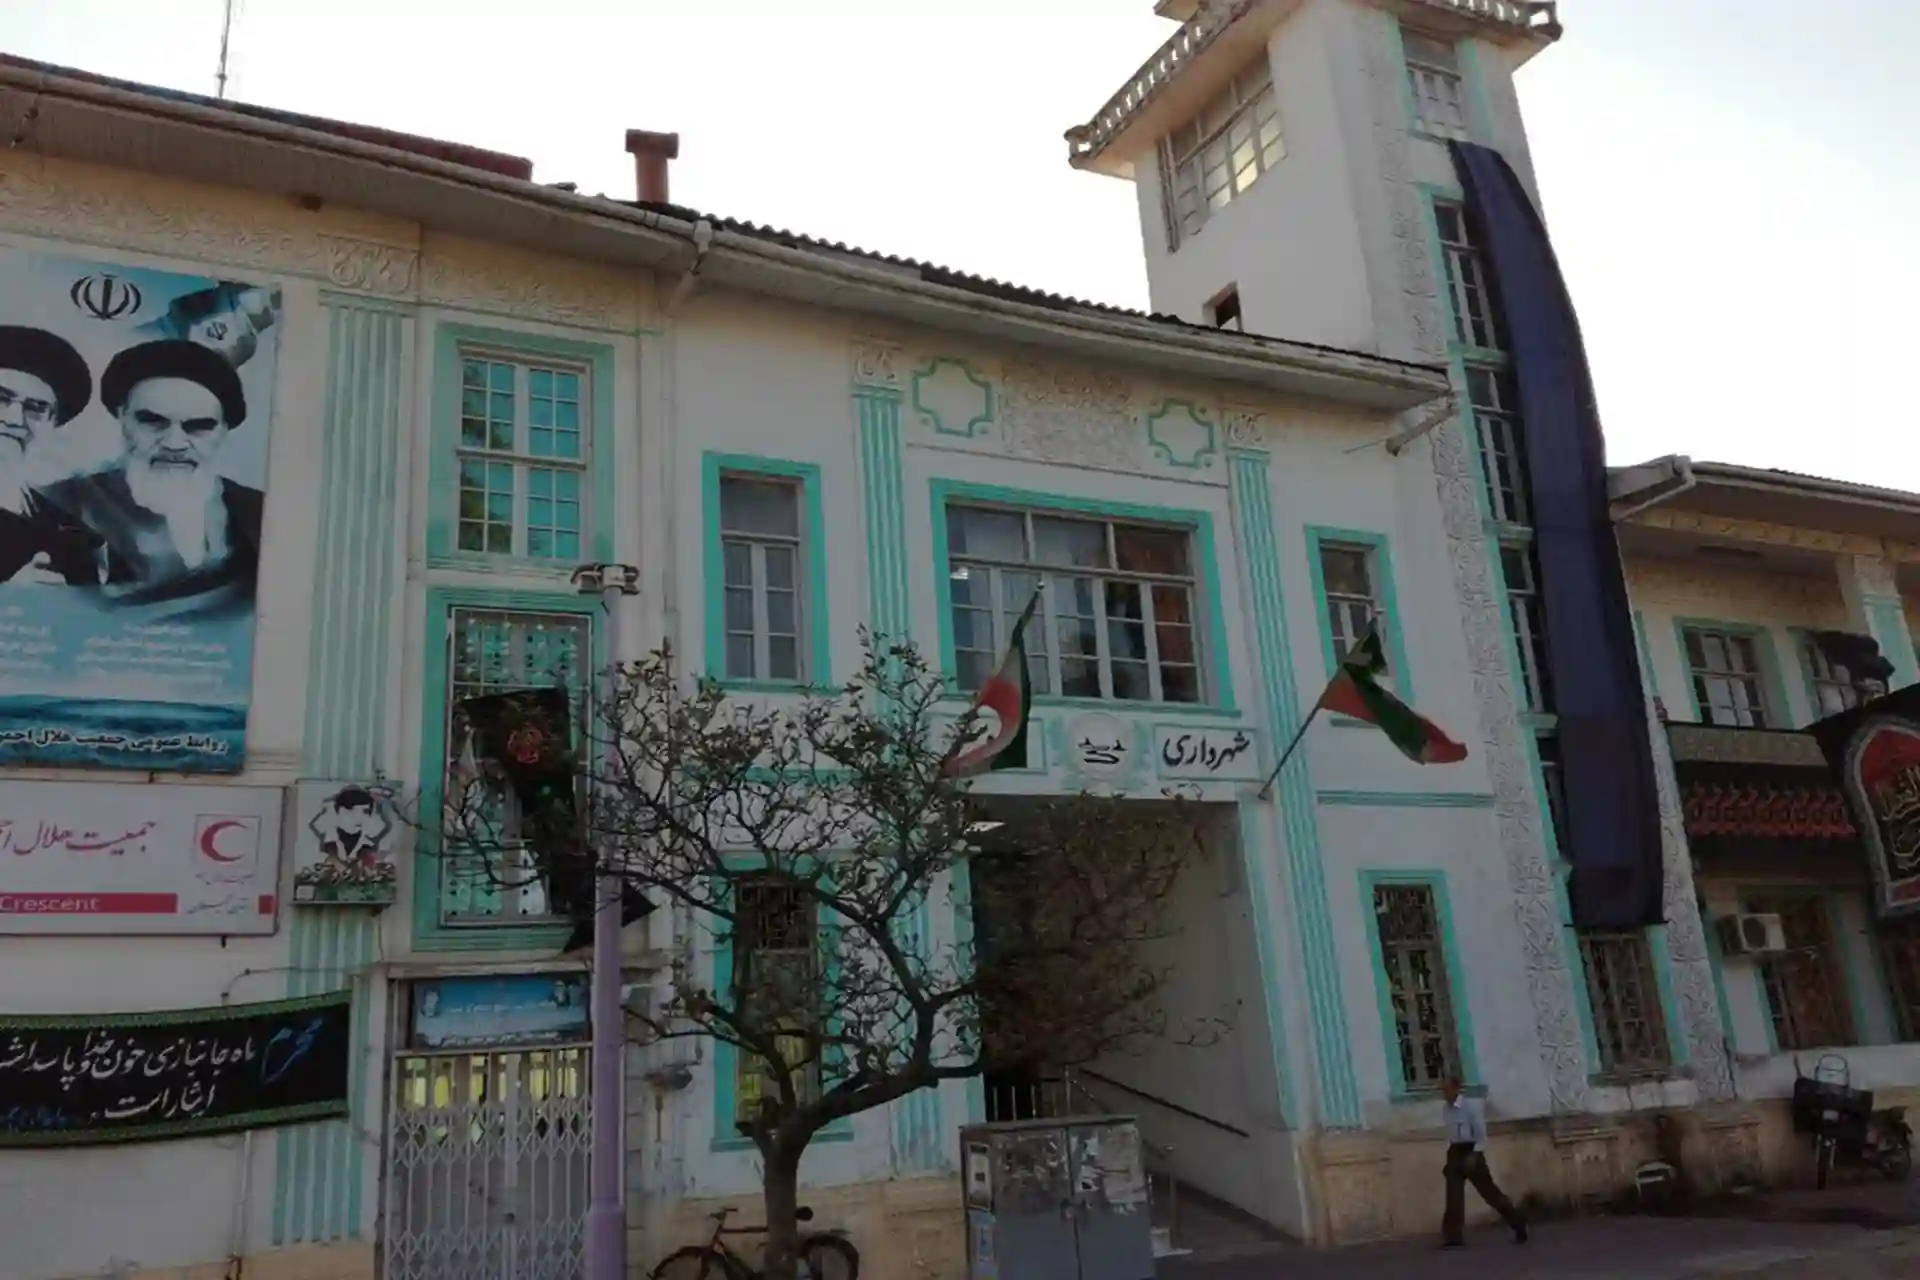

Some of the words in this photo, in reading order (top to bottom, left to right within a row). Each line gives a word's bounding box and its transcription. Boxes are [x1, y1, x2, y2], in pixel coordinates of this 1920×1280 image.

[36, 728, 72, 746] هلال
[1163, 731, 1250, 771] شهرداری
[14, 819, 74, 855] هلال
[66, 821, 156, 855] جمعیت
[0, 896, 100, 911] Crescent
[84, 1031, 114, 1058] خدا
[91, 1038, 145, 1078] خون
[144, 1036, 230, 1077] جانبازی
[231, 1037, 255, 1064] ماه
[76, 1056, 90, 1075] و
[170, 1078, 216, 1118] ایثار
